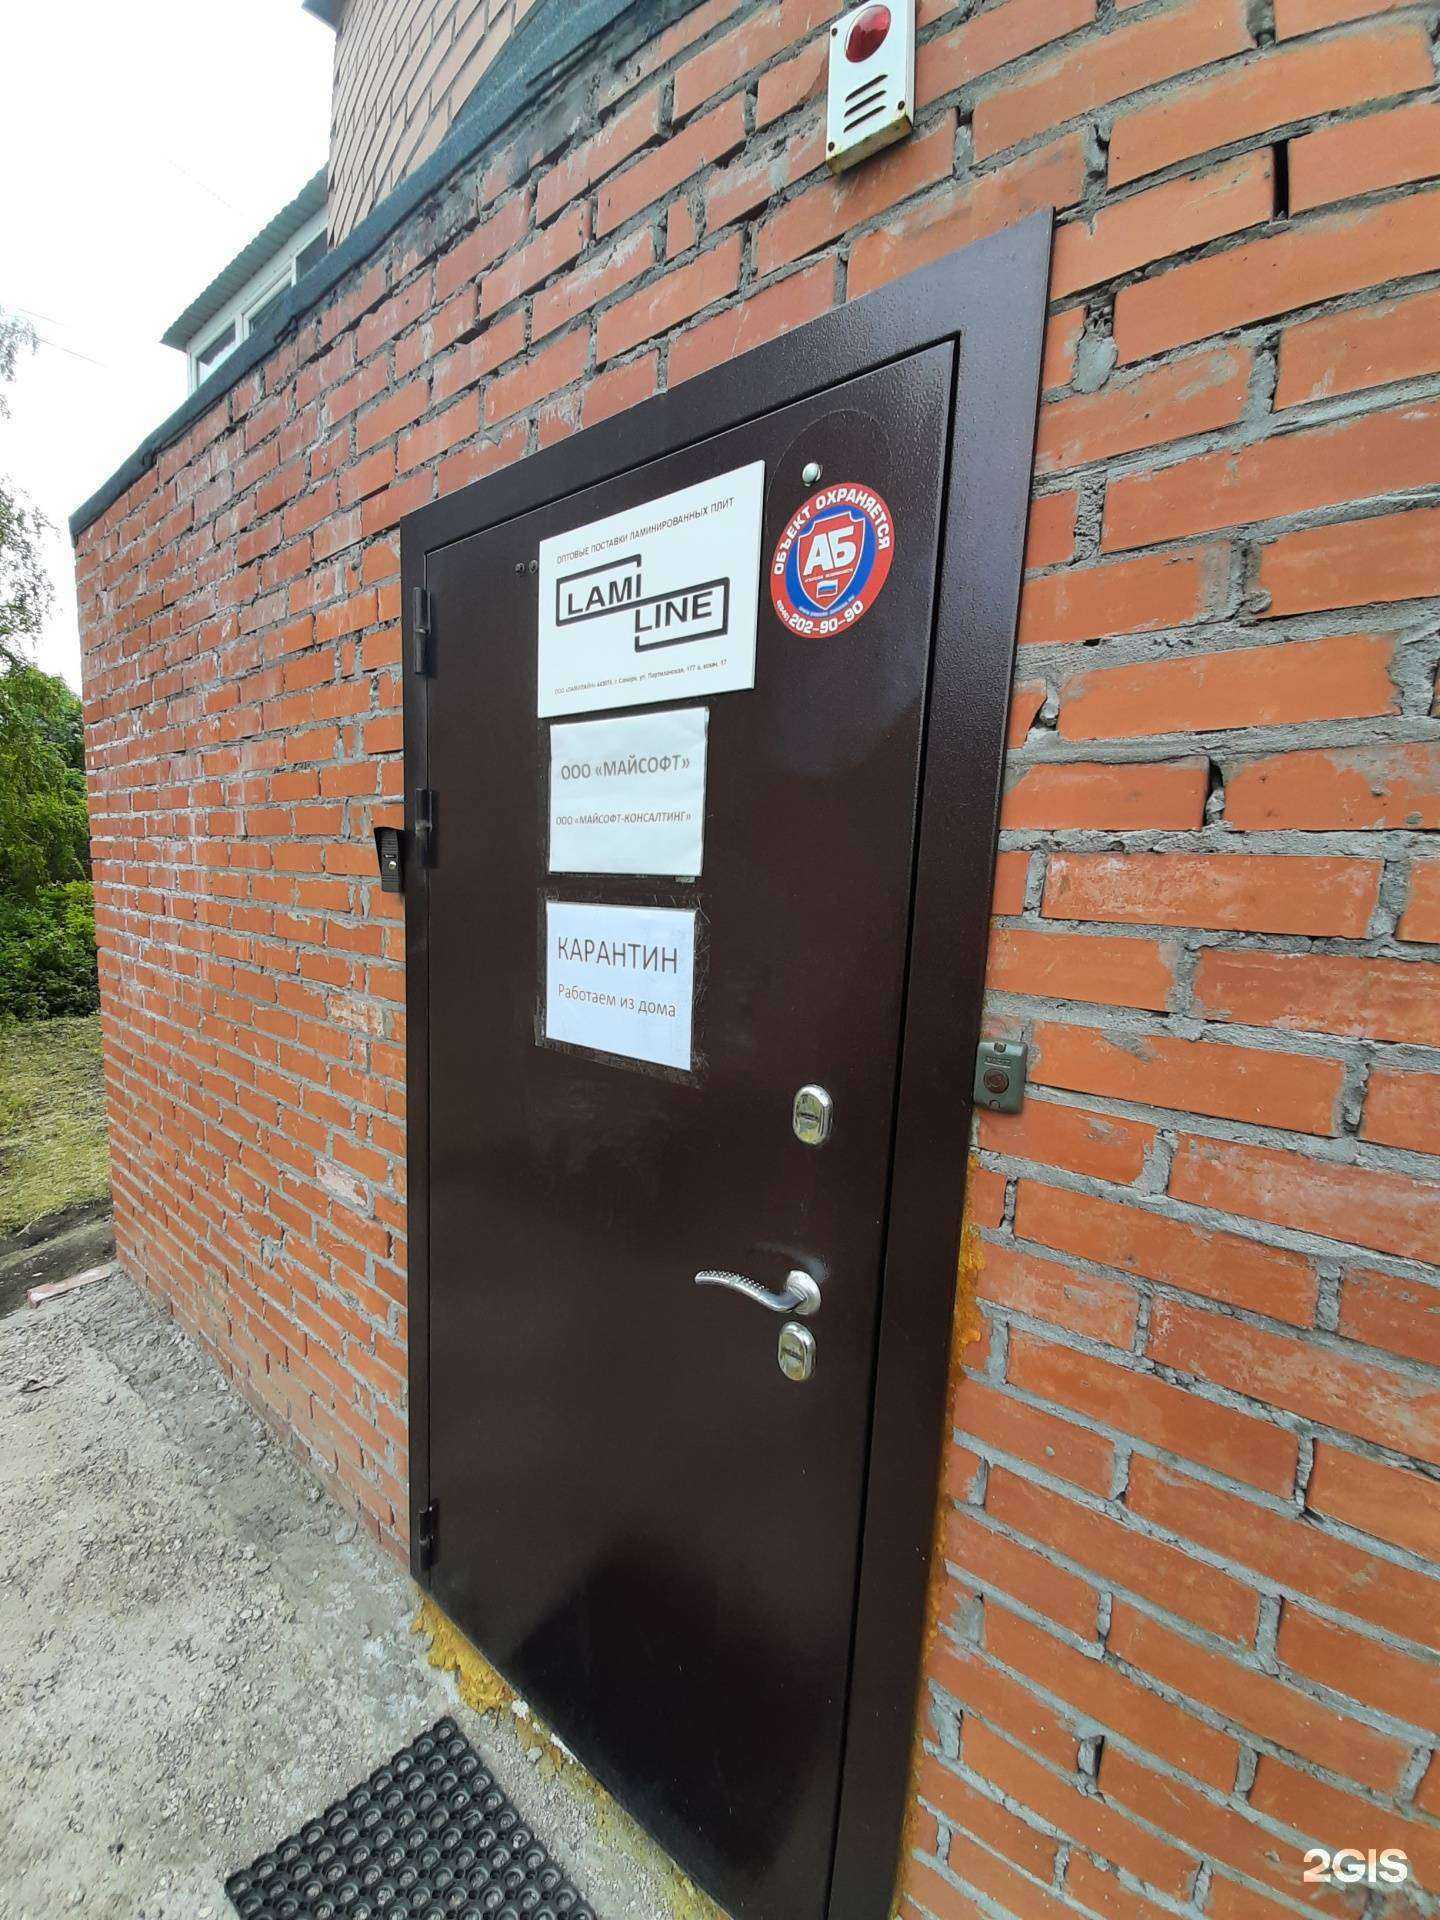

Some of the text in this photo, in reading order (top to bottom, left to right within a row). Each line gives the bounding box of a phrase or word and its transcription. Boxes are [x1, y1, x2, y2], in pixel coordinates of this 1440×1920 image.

[557, 497, 735, 564] ОПТОВЫЕ ПОСТАВКИ ЛАМИНИРОВАННЫХ ПЛИТ
[774, 488, 890, 575] ОБЪЕКТ ОХРАНЯЕТСЯ
[803, 525, 857, 576] АБ
[568, 573, 641, 615] LAMI
[635, 590, 713, 633] LINE
[789, 600, 864, 634] 202-90-90
[561, 754, 690, 780] ООО «МАЙСОФТ»
[556, 811, 691, 825] ООО «МАЙСОФТ-КОНСАЛТИНГ»
[558, 937, 677, 974] КАРАНТИН
[558, 984, 676, 1017] Работаем из дома
